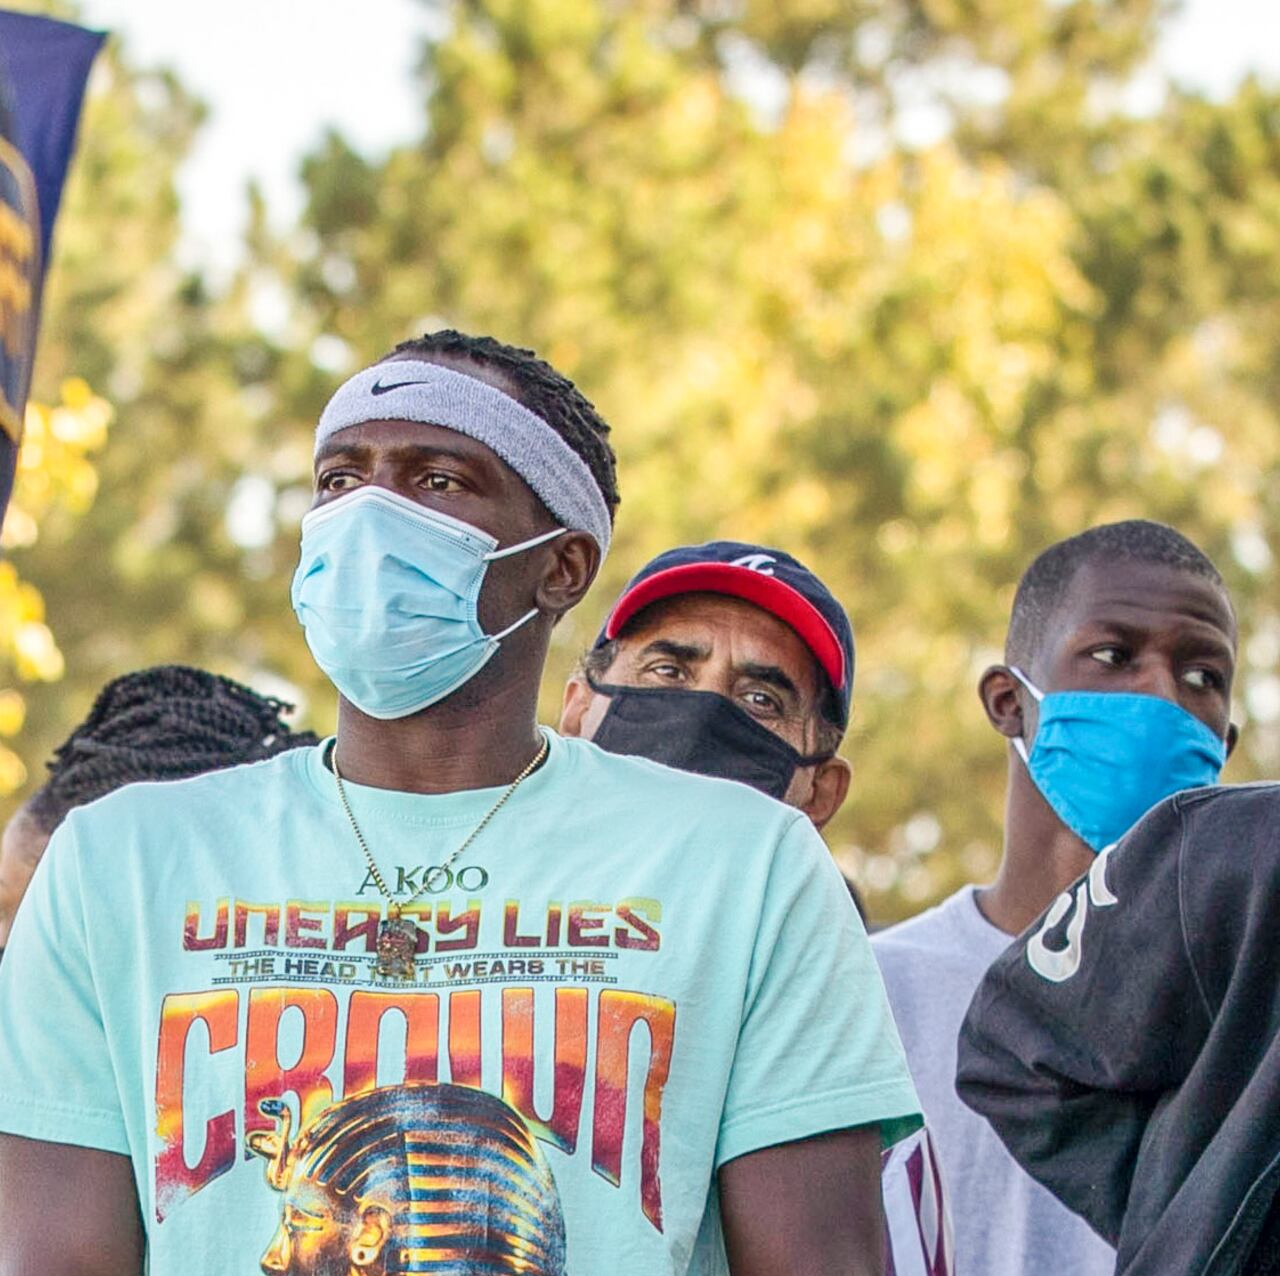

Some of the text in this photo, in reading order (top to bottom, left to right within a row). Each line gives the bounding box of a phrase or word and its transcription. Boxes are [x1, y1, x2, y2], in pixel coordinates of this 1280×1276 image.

[355, 866, 489, 895] AKOO
[503, 896, 663, 952] LIES
[228, 958, 275, 976] THE
[284, 958, 356, 979] HEAD
[367, 963, 434, 982] TT
[555, 959, 606, 976] THE
[155, 986, 678, 1235] CROWN
